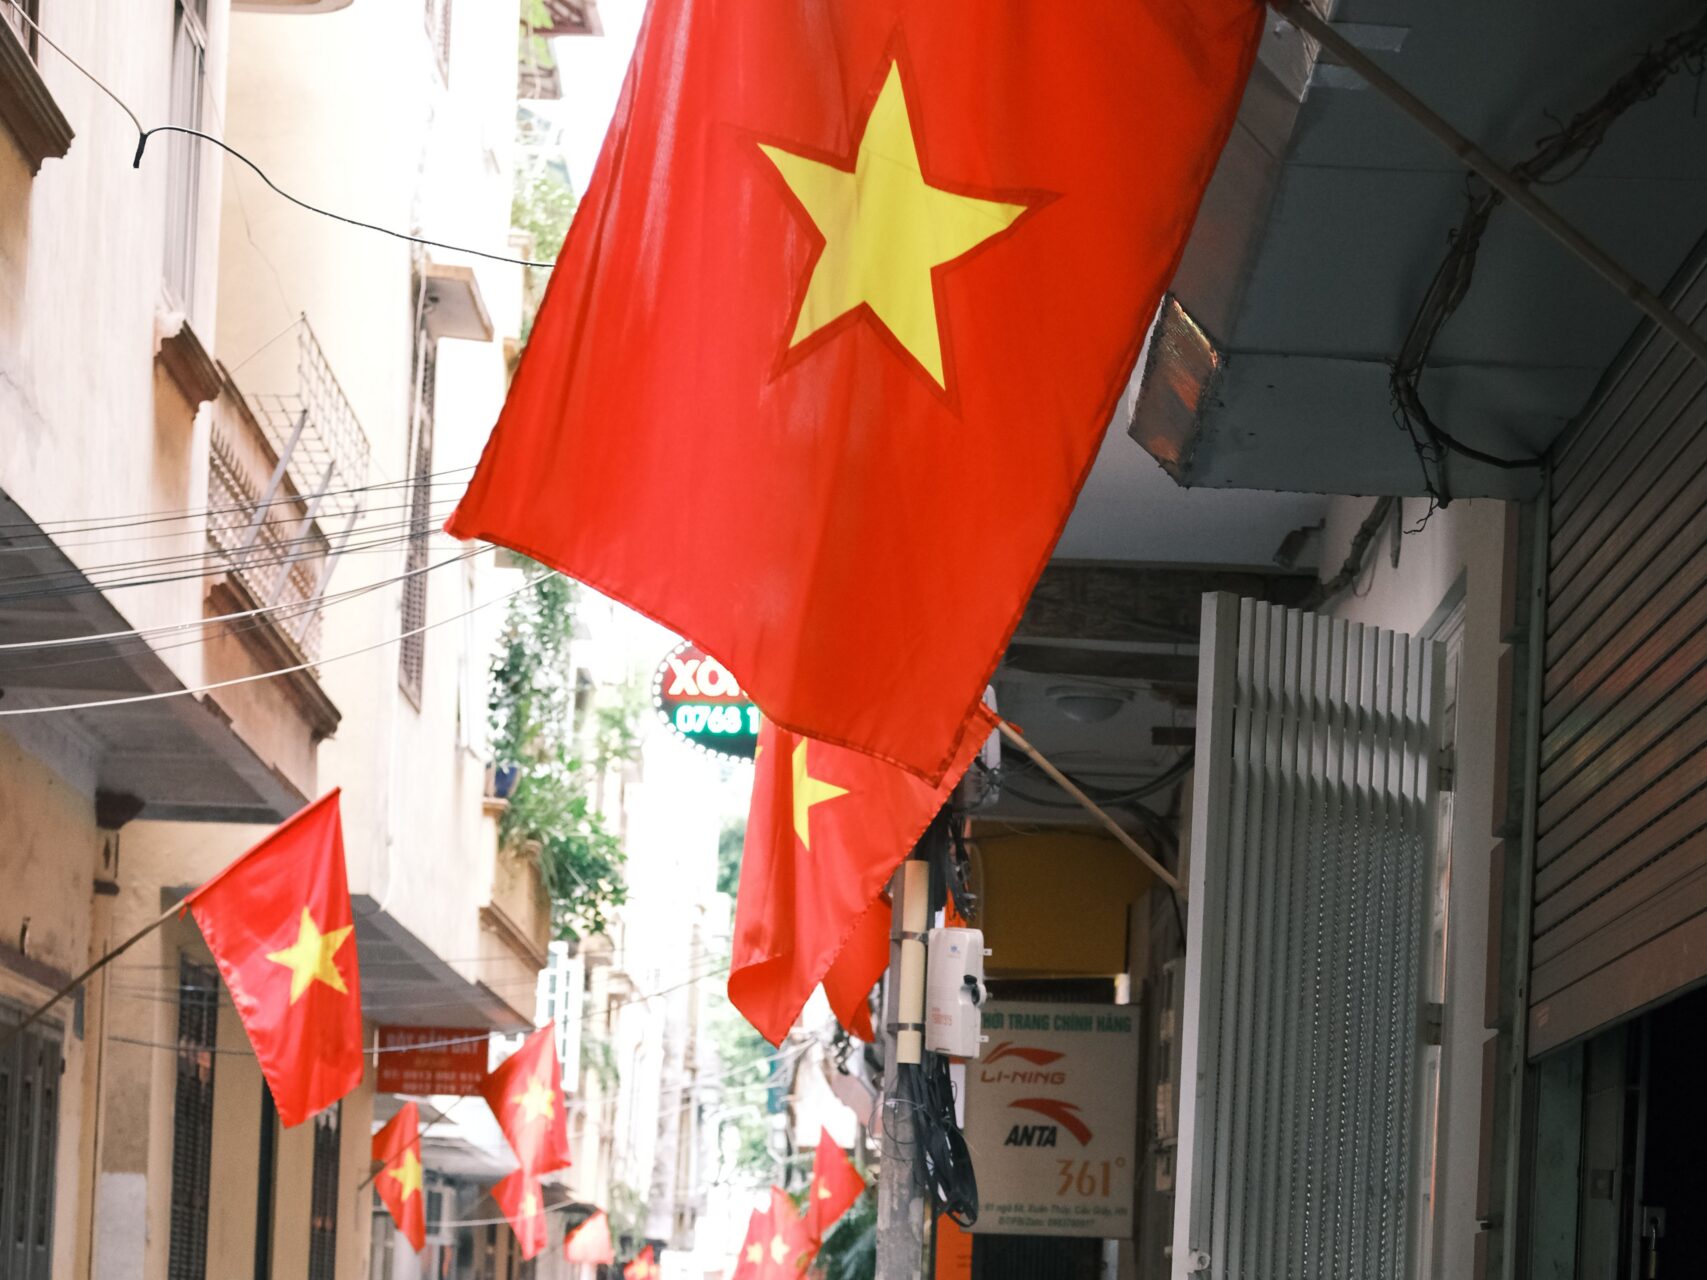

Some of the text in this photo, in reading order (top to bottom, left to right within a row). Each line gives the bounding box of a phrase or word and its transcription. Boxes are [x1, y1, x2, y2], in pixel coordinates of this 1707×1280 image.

[1008, 1012, 1050, 1031] TRANG
[981, 1071, 1067, 1085] LI-NING
[1004, 1125, 1058, 1147] ANTA
